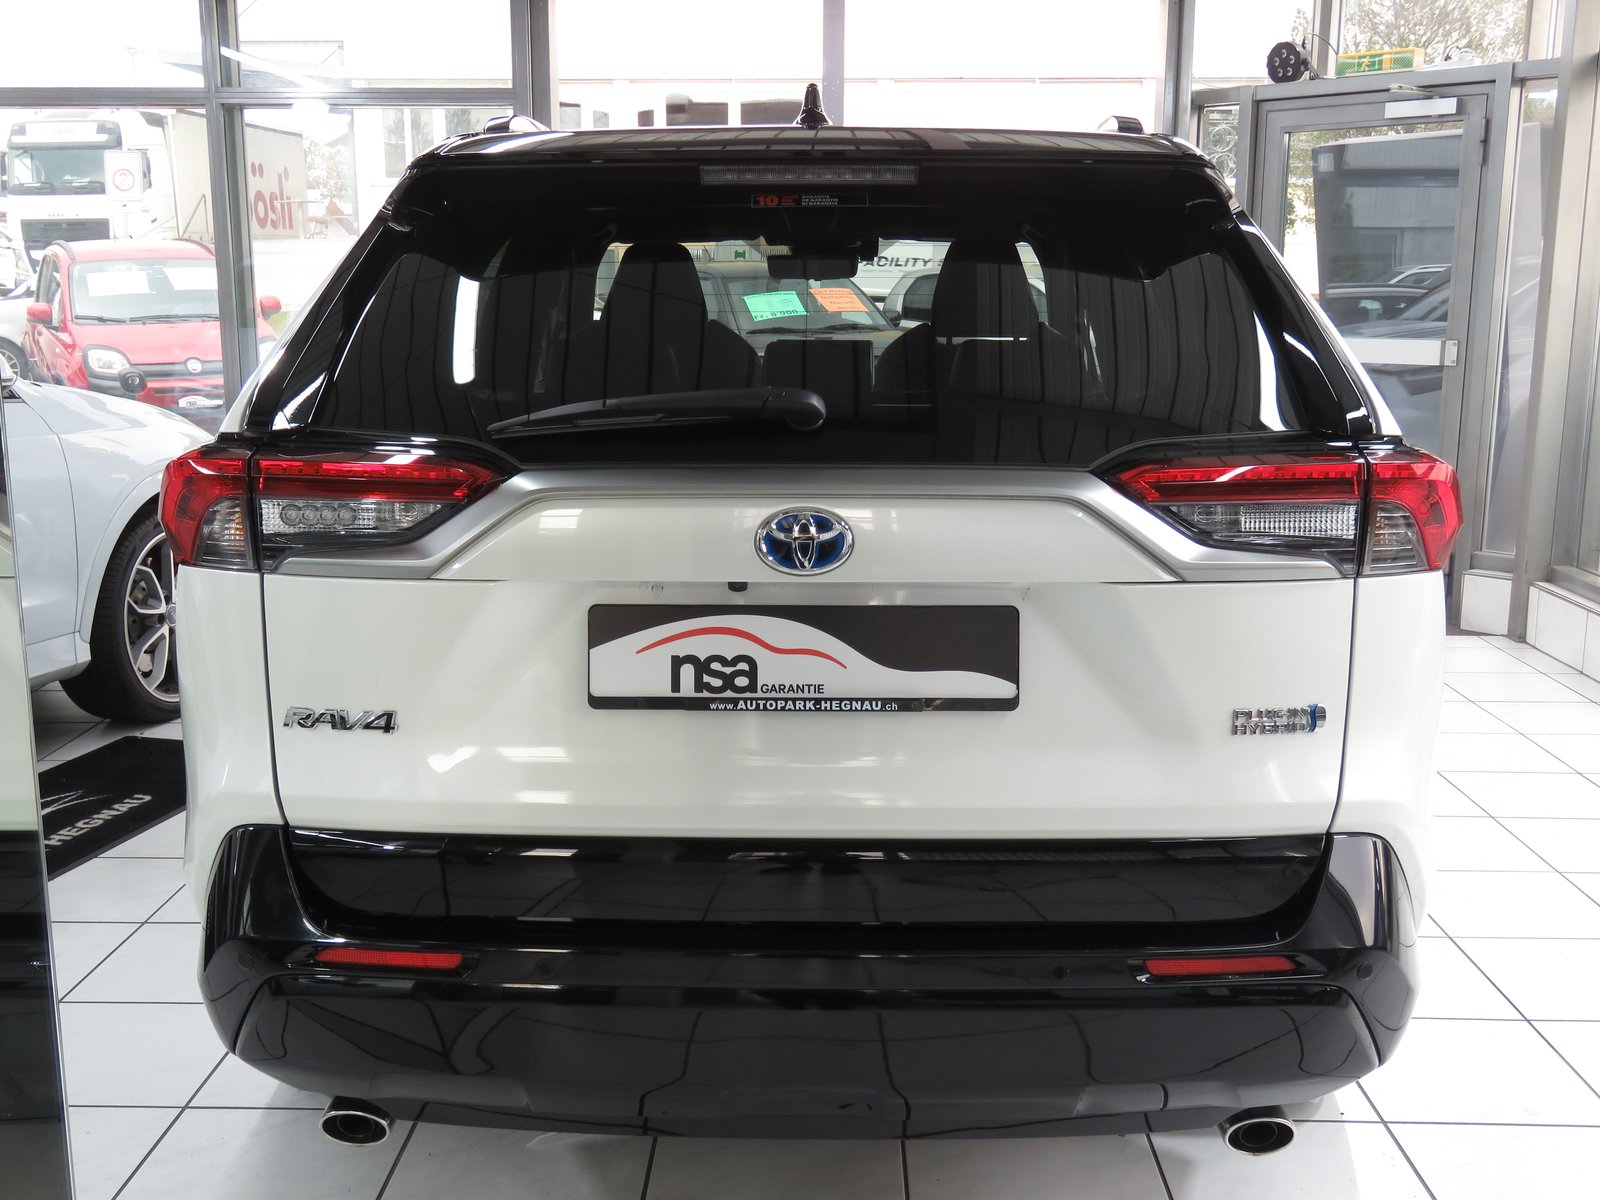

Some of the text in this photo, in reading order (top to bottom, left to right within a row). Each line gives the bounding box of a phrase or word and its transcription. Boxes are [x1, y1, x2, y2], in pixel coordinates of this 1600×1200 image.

[249, 162, 294, 230] ösli
[757, 195, 779, 206] 10
[858, 256, 933, 267] ACILITY
[670, 654, 758, 695] nsa
[760, 684, 825, 694] GARANTIE
[709, 700, 898, 711] www.AUTOPARK-HEGNAU.ch
[283, 706, 400, 734] RAV4
[1231, 720, 1307, 735] HYBRID
[44, 794, 153, 846] HEGNAU
